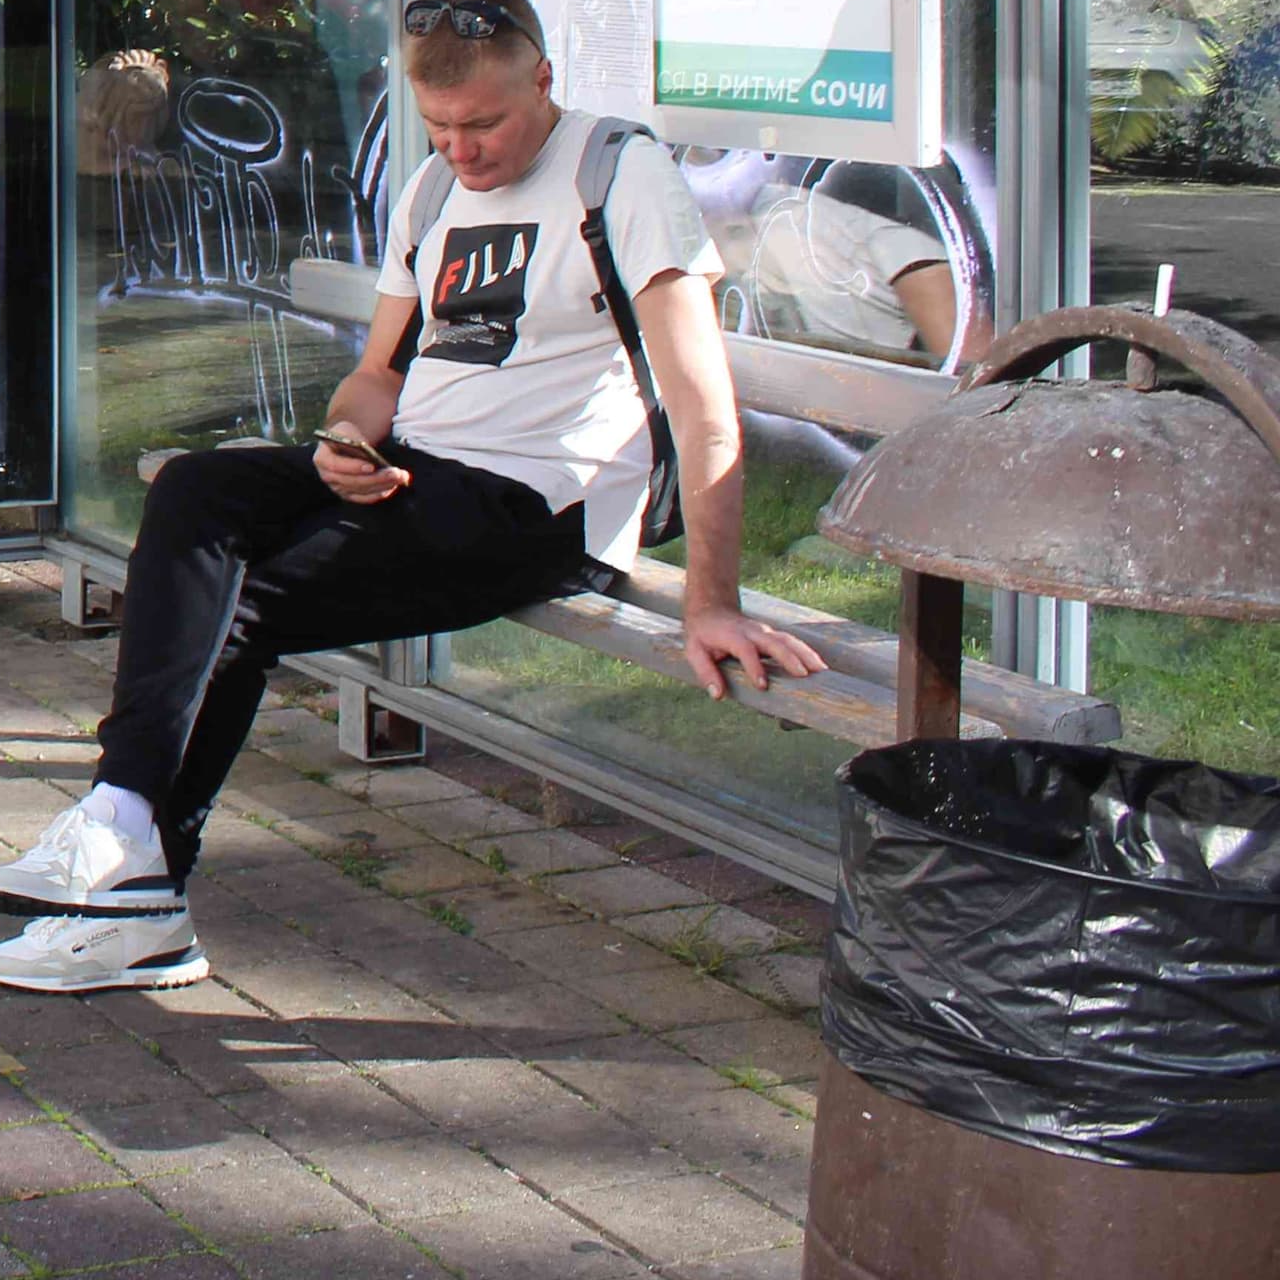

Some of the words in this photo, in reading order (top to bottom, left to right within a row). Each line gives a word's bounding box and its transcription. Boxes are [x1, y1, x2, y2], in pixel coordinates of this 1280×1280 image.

[693, 72, 708, 97] В
[717, 73, 802, 104] РИТМЕ
[810, 79, 888, 110] СОЧИ
[438, 232, 525, 304] FILA
